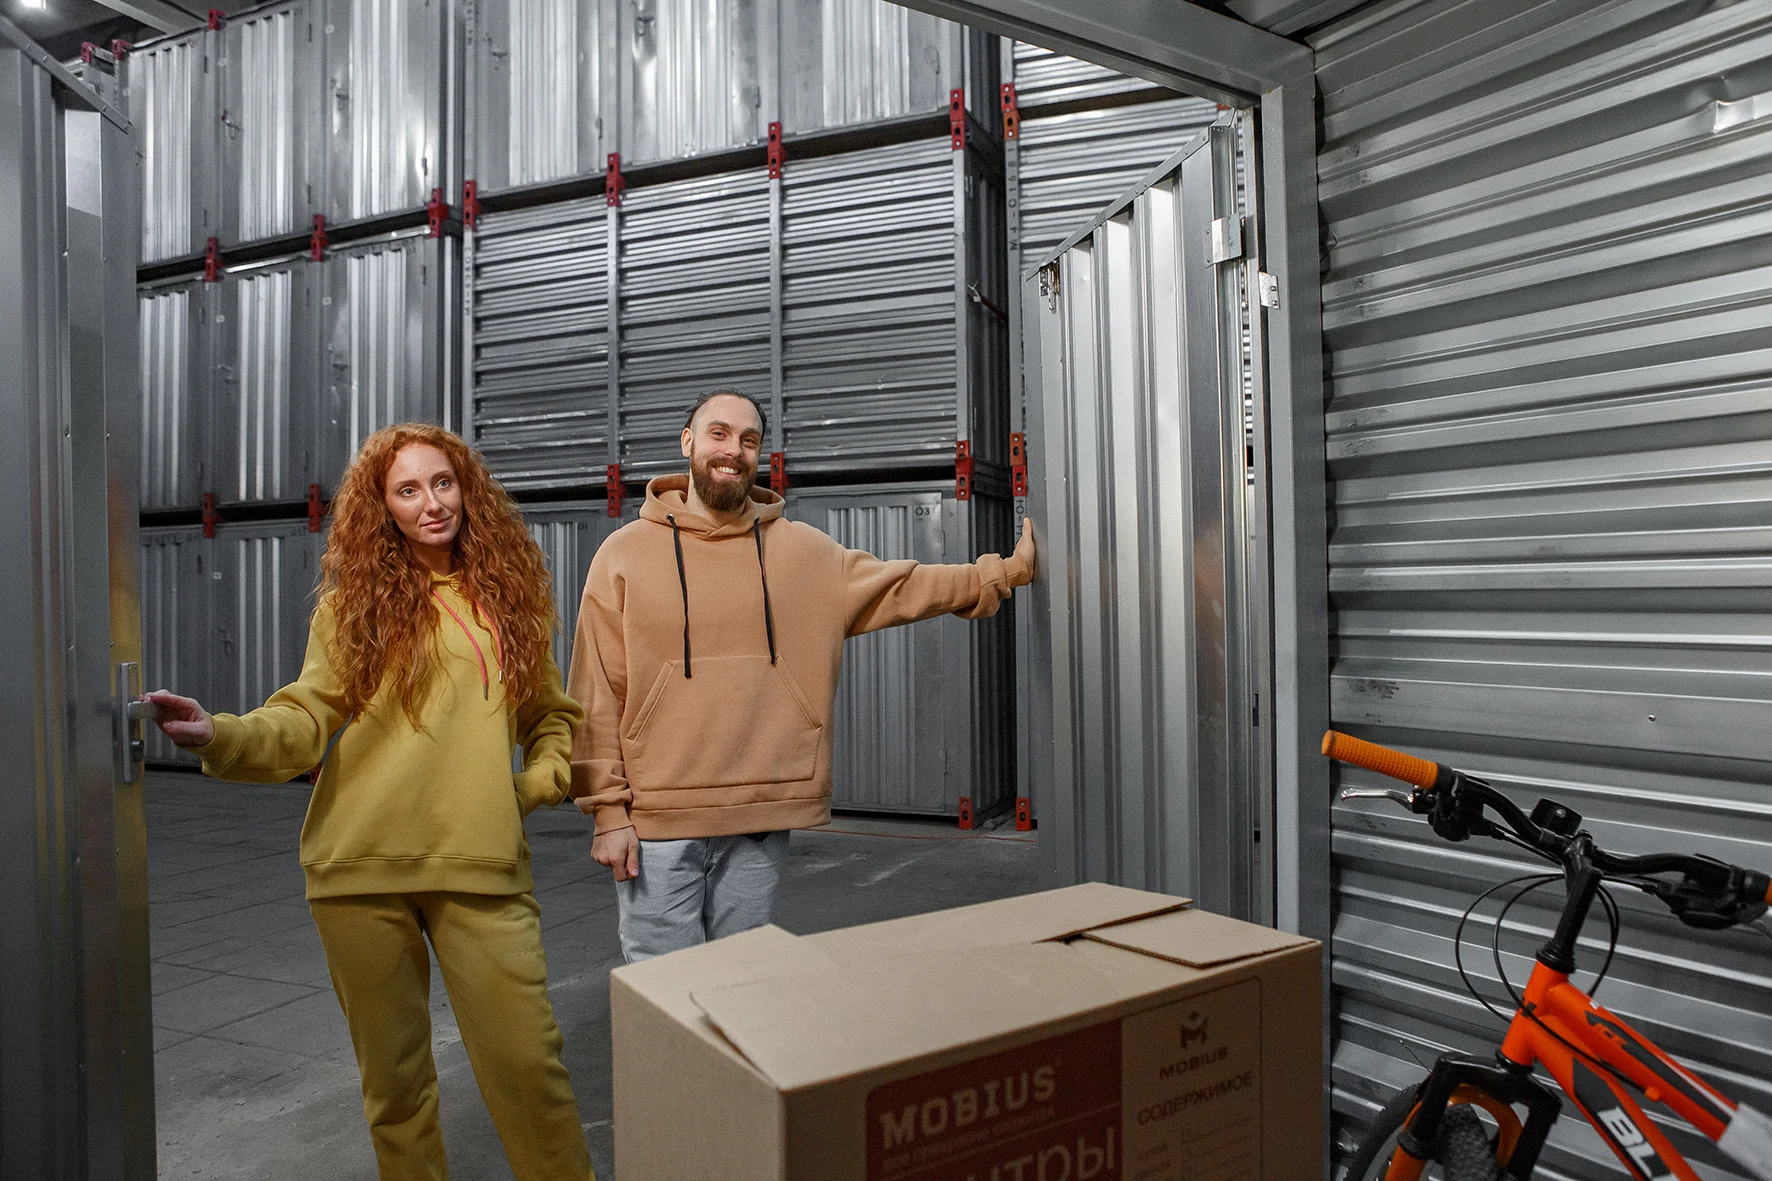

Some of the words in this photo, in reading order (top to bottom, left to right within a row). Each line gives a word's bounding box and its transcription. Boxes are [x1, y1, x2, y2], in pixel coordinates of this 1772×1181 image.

[1159, 1046, 1228, 1081] MOBIUS
[879, 1065, 1056, 1150] MOBIUS
[1138, 1070, 1253, 1125] СОДЕРЖИМОЕ
